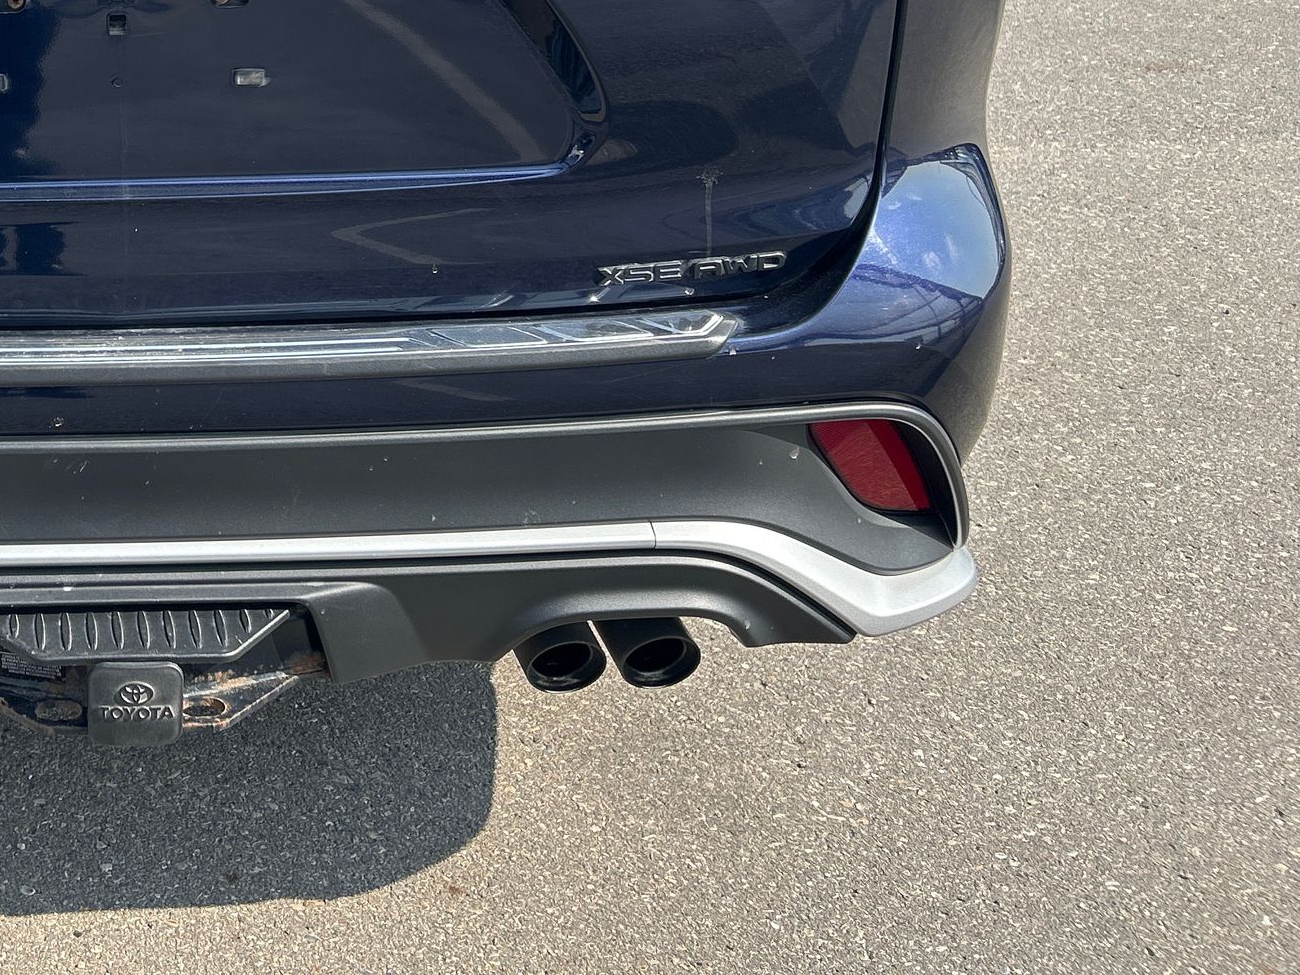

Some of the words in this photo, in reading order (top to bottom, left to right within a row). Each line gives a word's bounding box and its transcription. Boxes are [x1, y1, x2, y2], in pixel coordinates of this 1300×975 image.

[596, 259, 683, 286] XSE
[687, 250, 787, 280] AWD
[99, 705, 175, 721] TOYOTA
